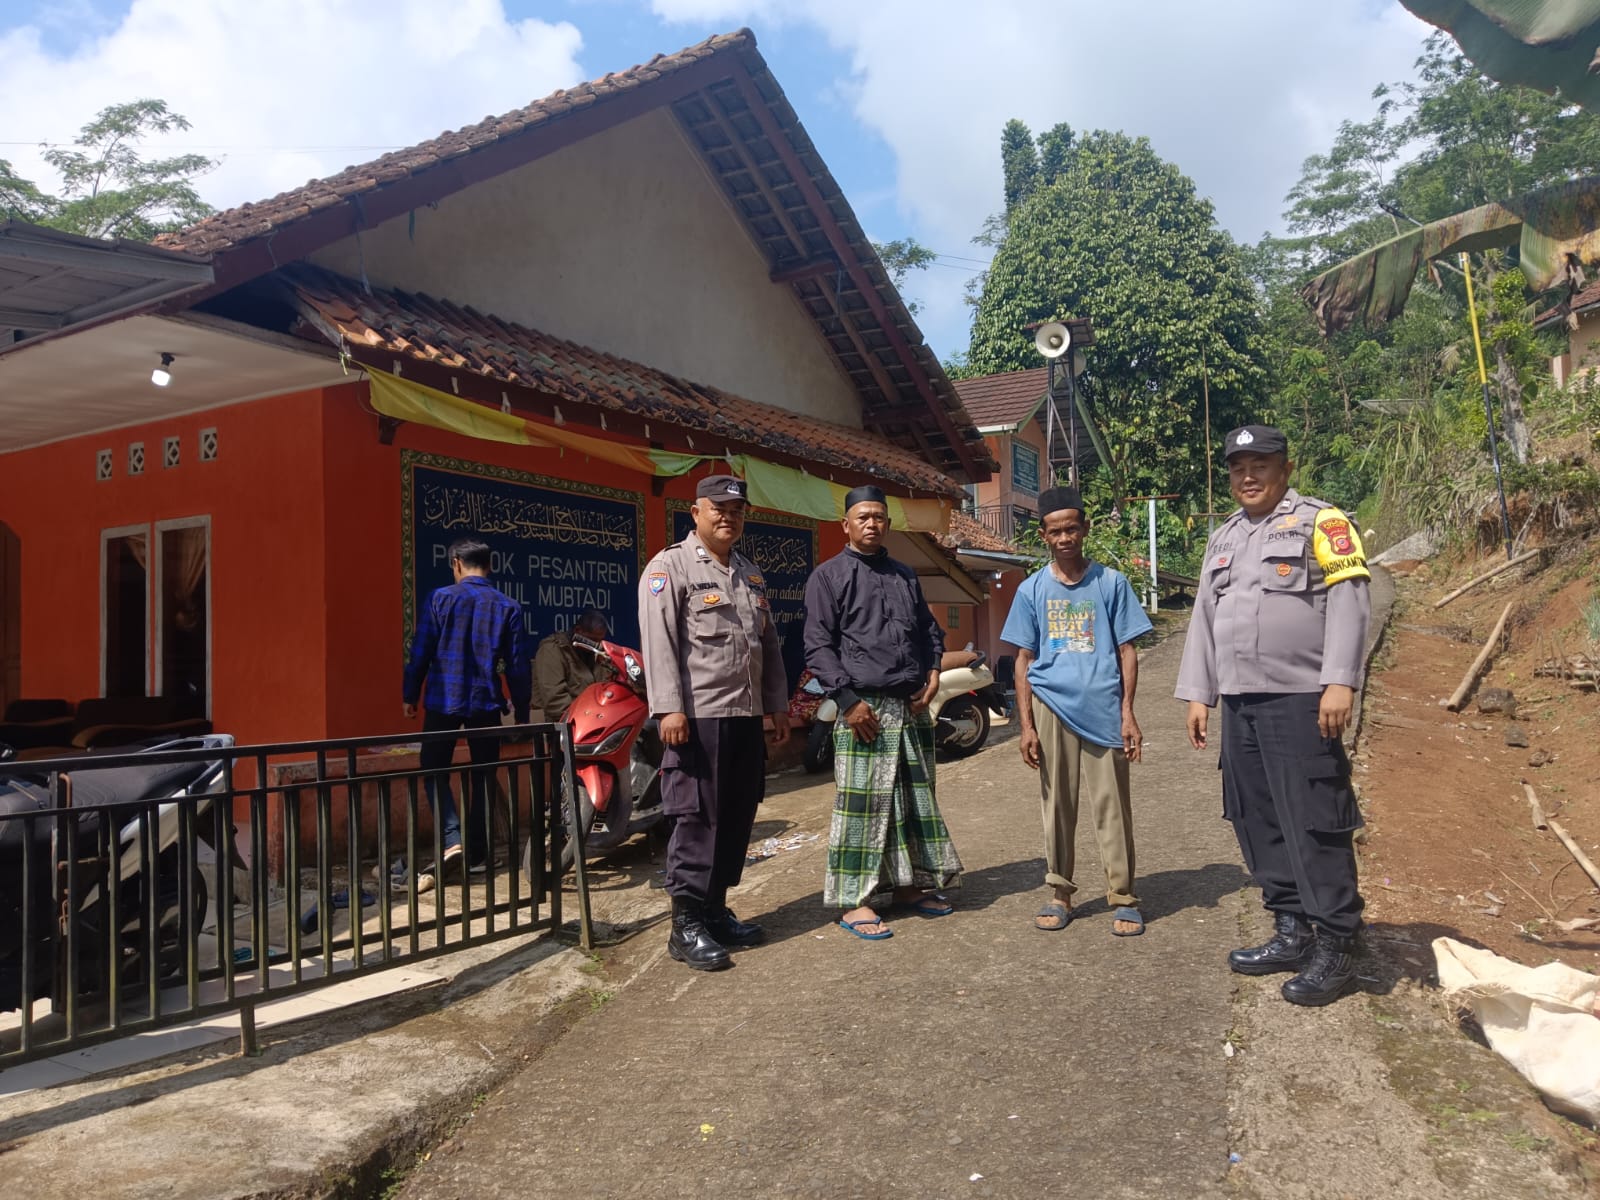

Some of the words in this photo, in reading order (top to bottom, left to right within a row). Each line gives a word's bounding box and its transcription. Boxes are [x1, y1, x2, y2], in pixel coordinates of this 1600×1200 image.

[1268, 530, 1298, 541] POLRI
[432, 543, 515, 575] POK
[528, 554, 628, 585] PESANTREN
[538, 583, 611, 610] MUBTADI
